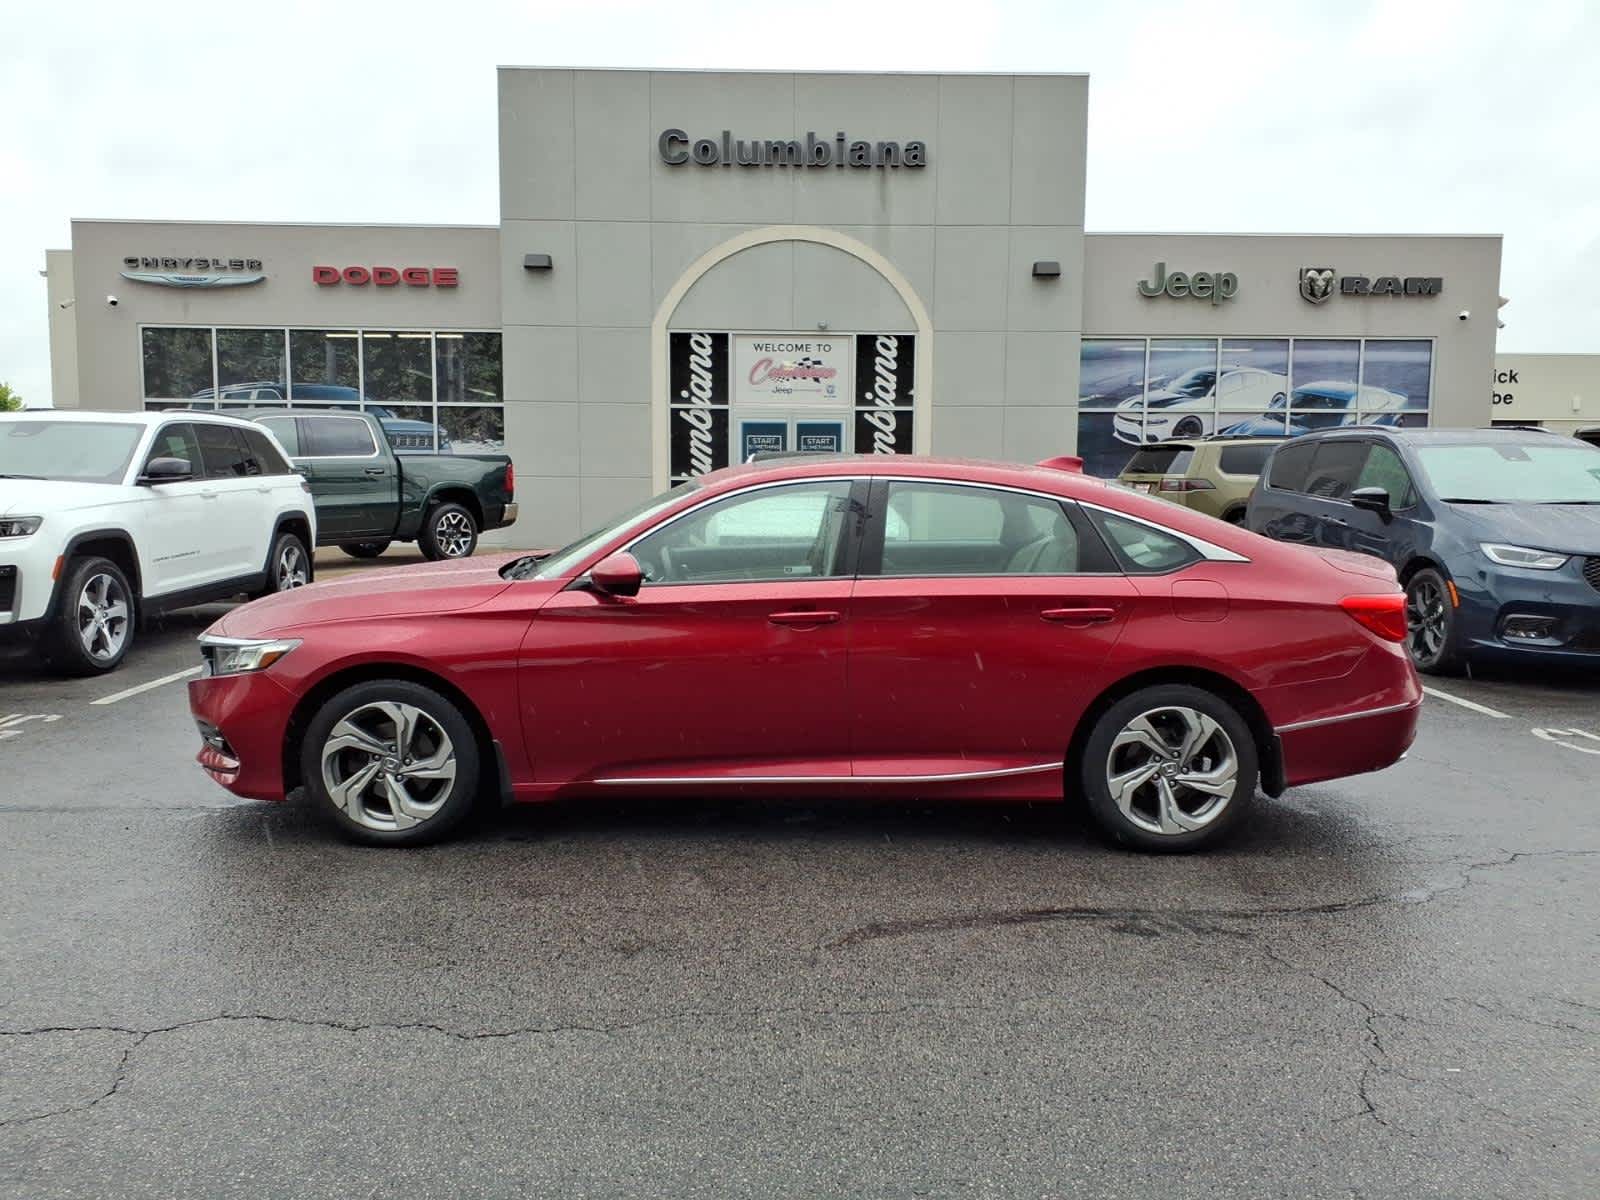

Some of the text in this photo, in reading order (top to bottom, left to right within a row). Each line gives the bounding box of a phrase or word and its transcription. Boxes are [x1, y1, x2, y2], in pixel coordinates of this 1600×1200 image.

[658, 128, 927, 168] Columbiana
[124, 257, 263, 270] CHRYSLER
[313, 266, 458, 286] DODGE
[1138, 262, 1239, 305] Jeep
[1340, 276, 1443, 296] RAM
[753, 343, 832, 353] WELCOME TO
